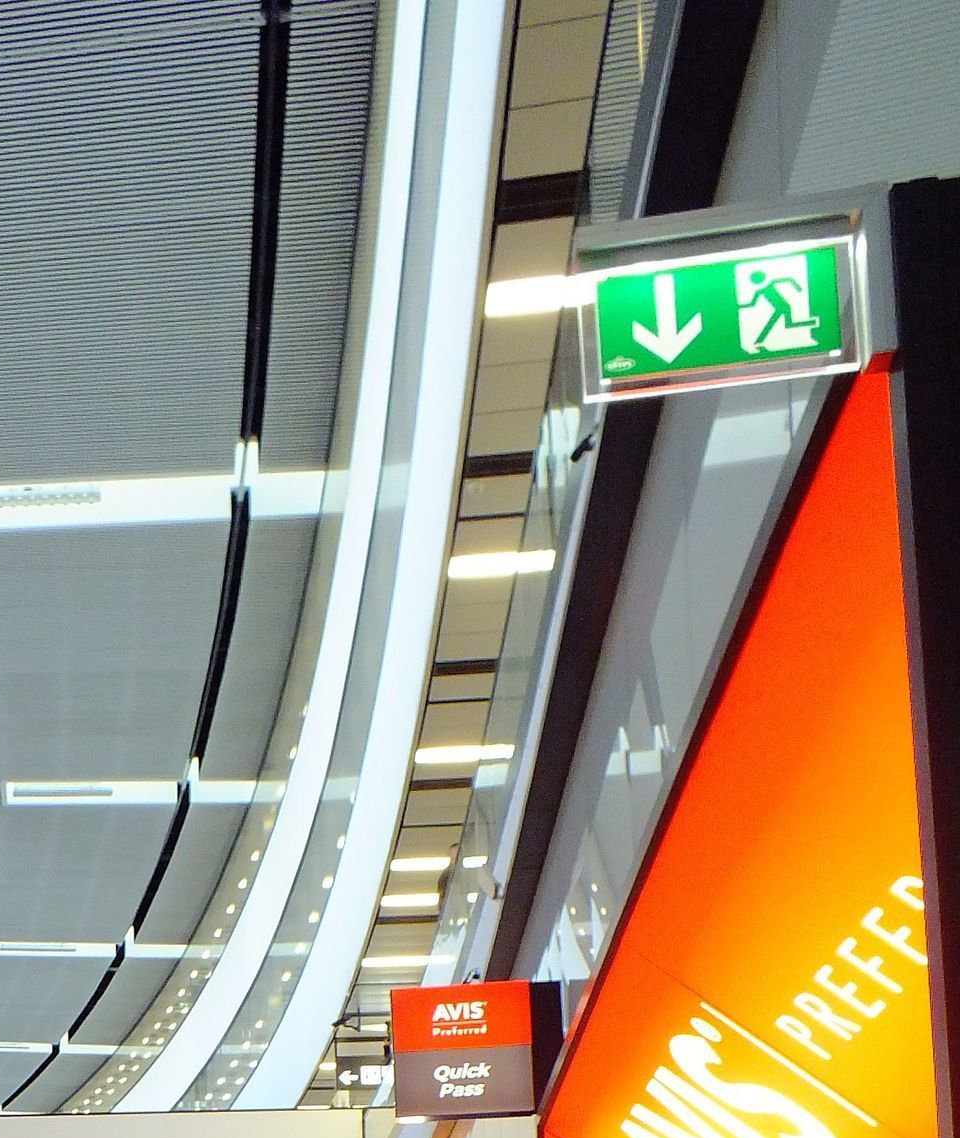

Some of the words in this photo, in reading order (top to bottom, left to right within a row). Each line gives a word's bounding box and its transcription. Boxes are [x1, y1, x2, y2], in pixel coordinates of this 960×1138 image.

[432, 1001, 486, 1022] AVIS
[432, 1025, 487, 1036] Preferred
[433, 1062, 492, 1081] Quick
[439, 1083, 486, 1099] Pass
